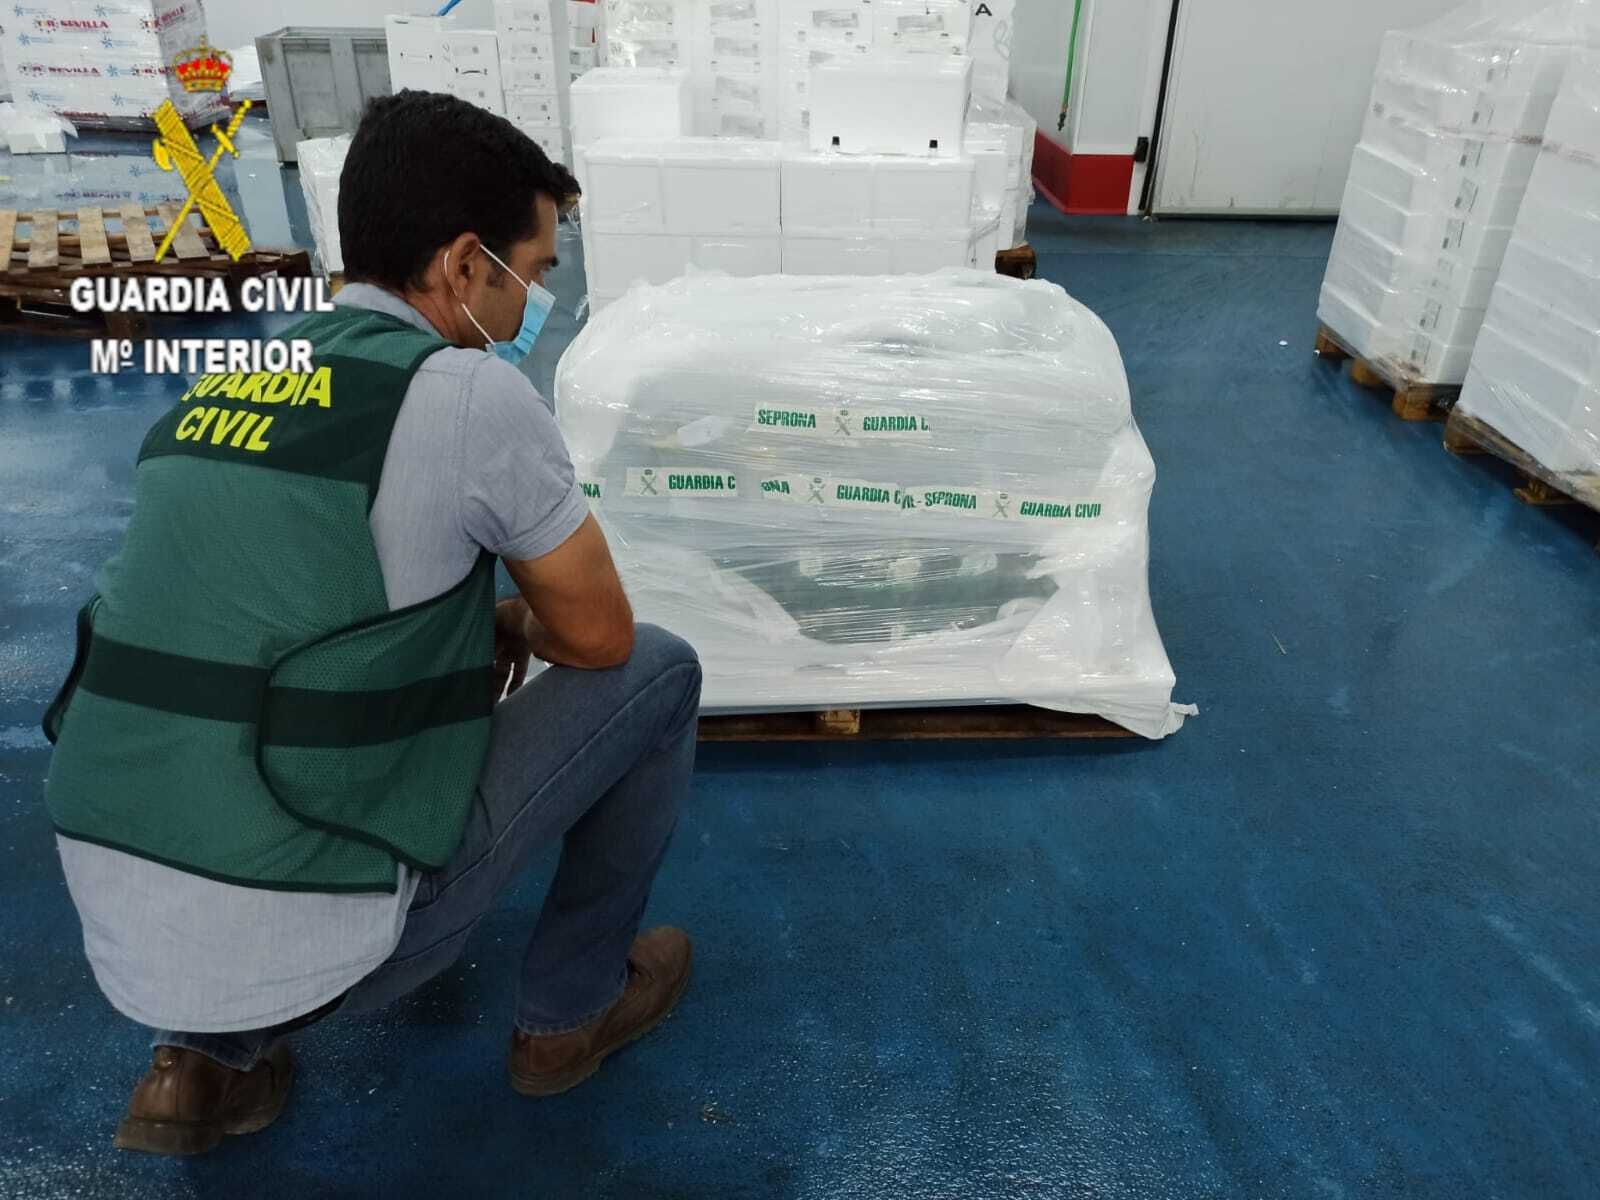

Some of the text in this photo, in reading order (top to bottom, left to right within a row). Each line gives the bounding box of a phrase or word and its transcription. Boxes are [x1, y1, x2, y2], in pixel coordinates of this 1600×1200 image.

[975, 3, 992, 16] A
[175, 406, 275, 451] CIVIL
[758, 408, 817, 429] SEPRONA
[862, 415, 917, 431] GUARDIA
[668, 474, 722, 490] GUARDIA
[836, 484, 890, 504] GUARDIA
[1020, 501, 1071, 518] GUARDIA
